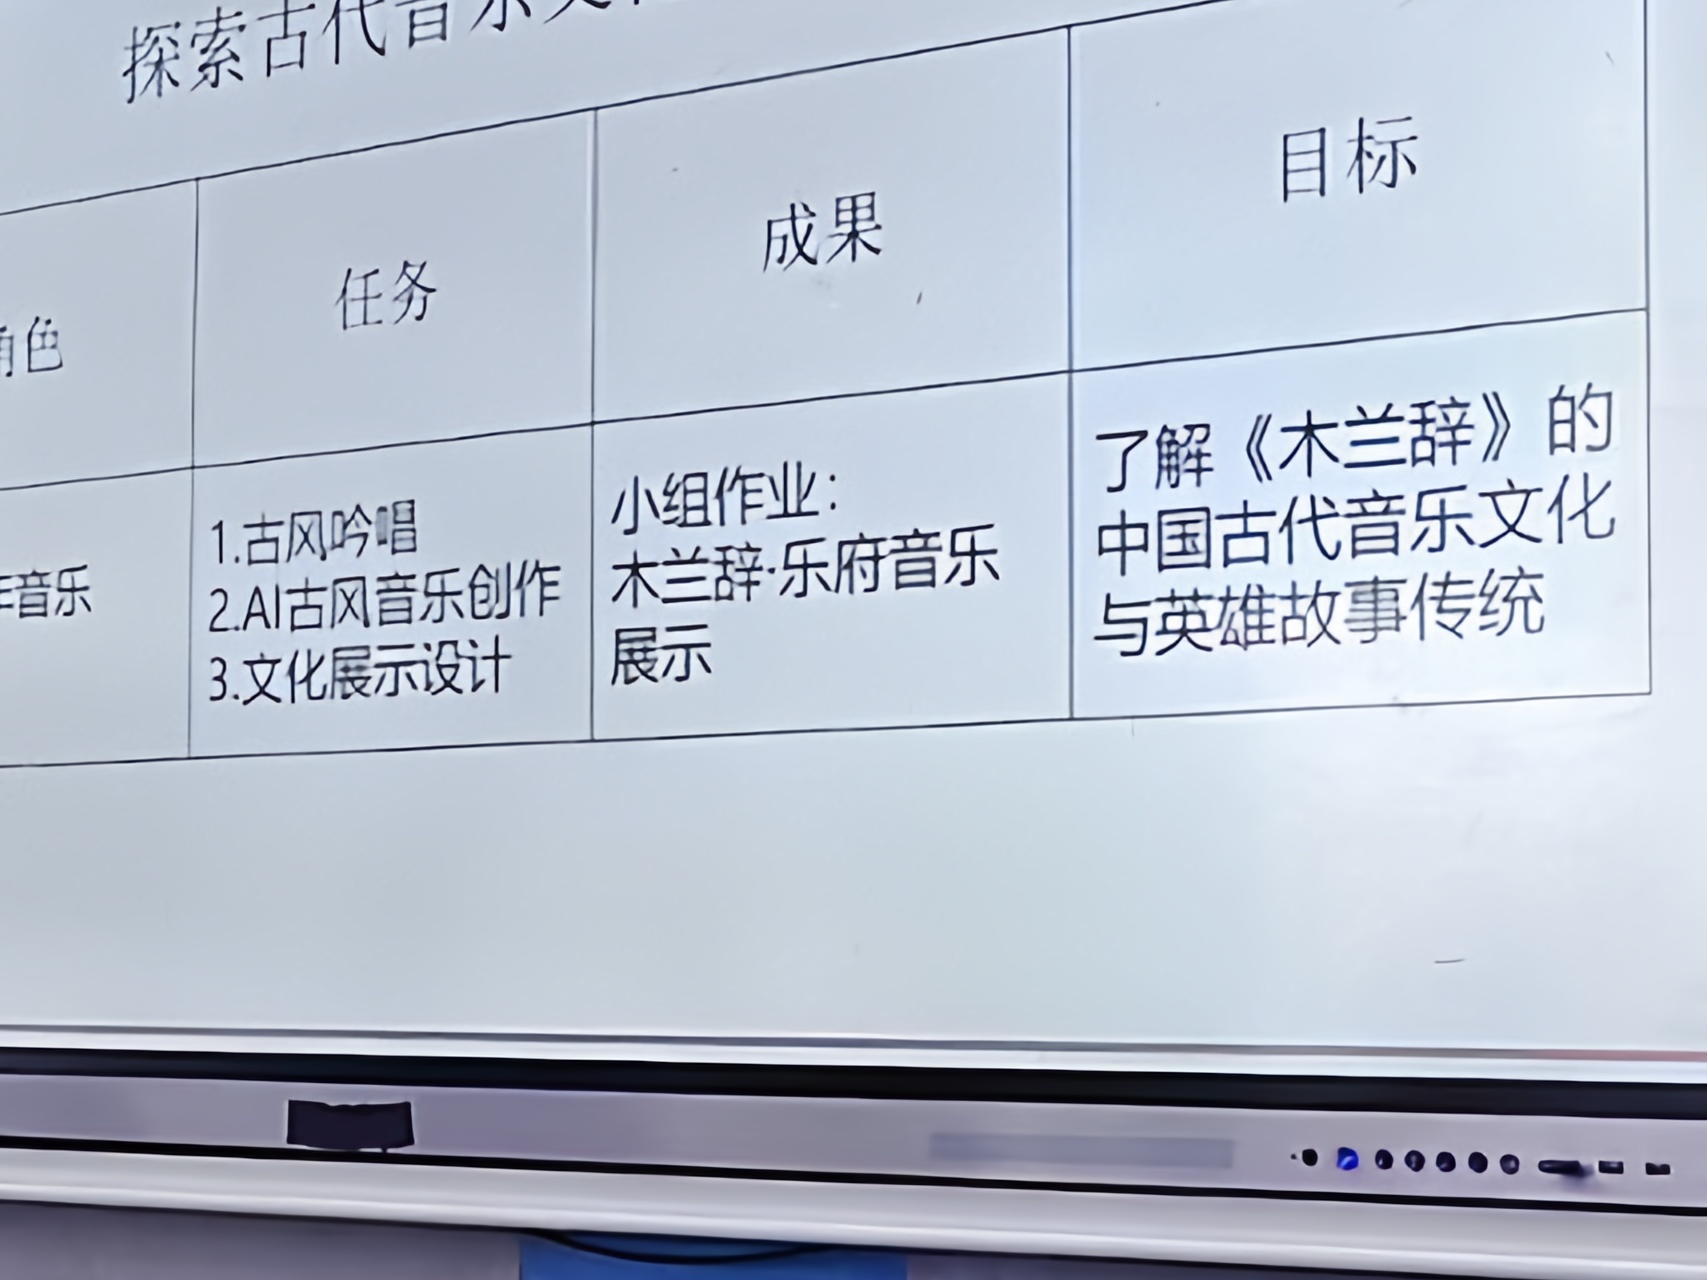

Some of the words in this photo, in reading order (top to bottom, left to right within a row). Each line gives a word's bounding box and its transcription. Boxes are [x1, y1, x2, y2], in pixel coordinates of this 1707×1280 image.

[1281, 116, 1418, 203] 目标
[762, 191, 883, 272] 成果
[334, 259, 437, 331] 任务
[1095, 381, 1614, 493] 了解《木兰辞》的
[210, 499, 417, 566] 1.古风吟唱
[1097, 472, 1617, 577] 中国古代音乐文化
[208, 560, 561, 633] 2.AI古风音乐创作
[1093, 565, 1545, 657] 与英雄故事传统
[209, 634, 512, 703] 3.文化展示设计
[610, 624, 712, 686] 展示
